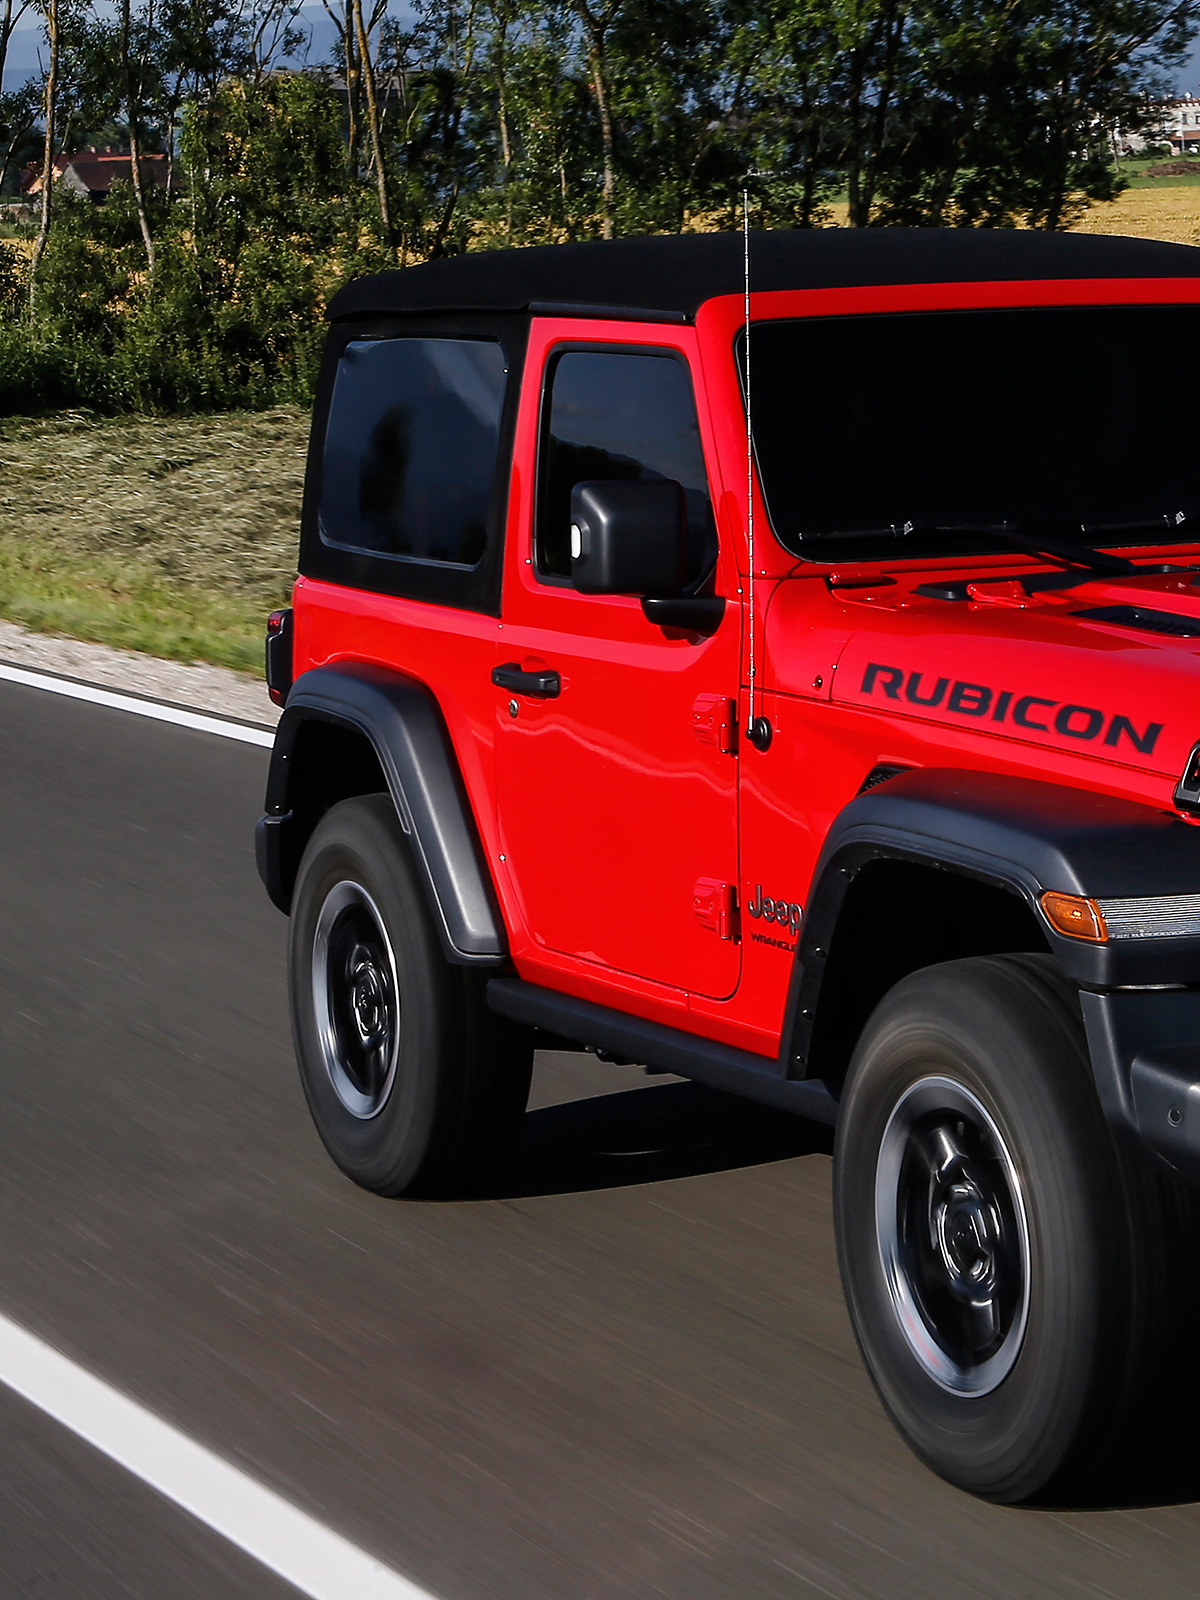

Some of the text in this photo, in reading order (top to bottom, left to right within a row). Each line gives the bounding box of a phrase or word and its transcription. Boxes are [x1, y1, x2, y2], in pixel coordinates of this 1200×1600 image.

[860, 662, 1165, 755] RUBICON
[748, 884, 803, 936] Jeep
[750, 931, 797, 952] WRANGLE
